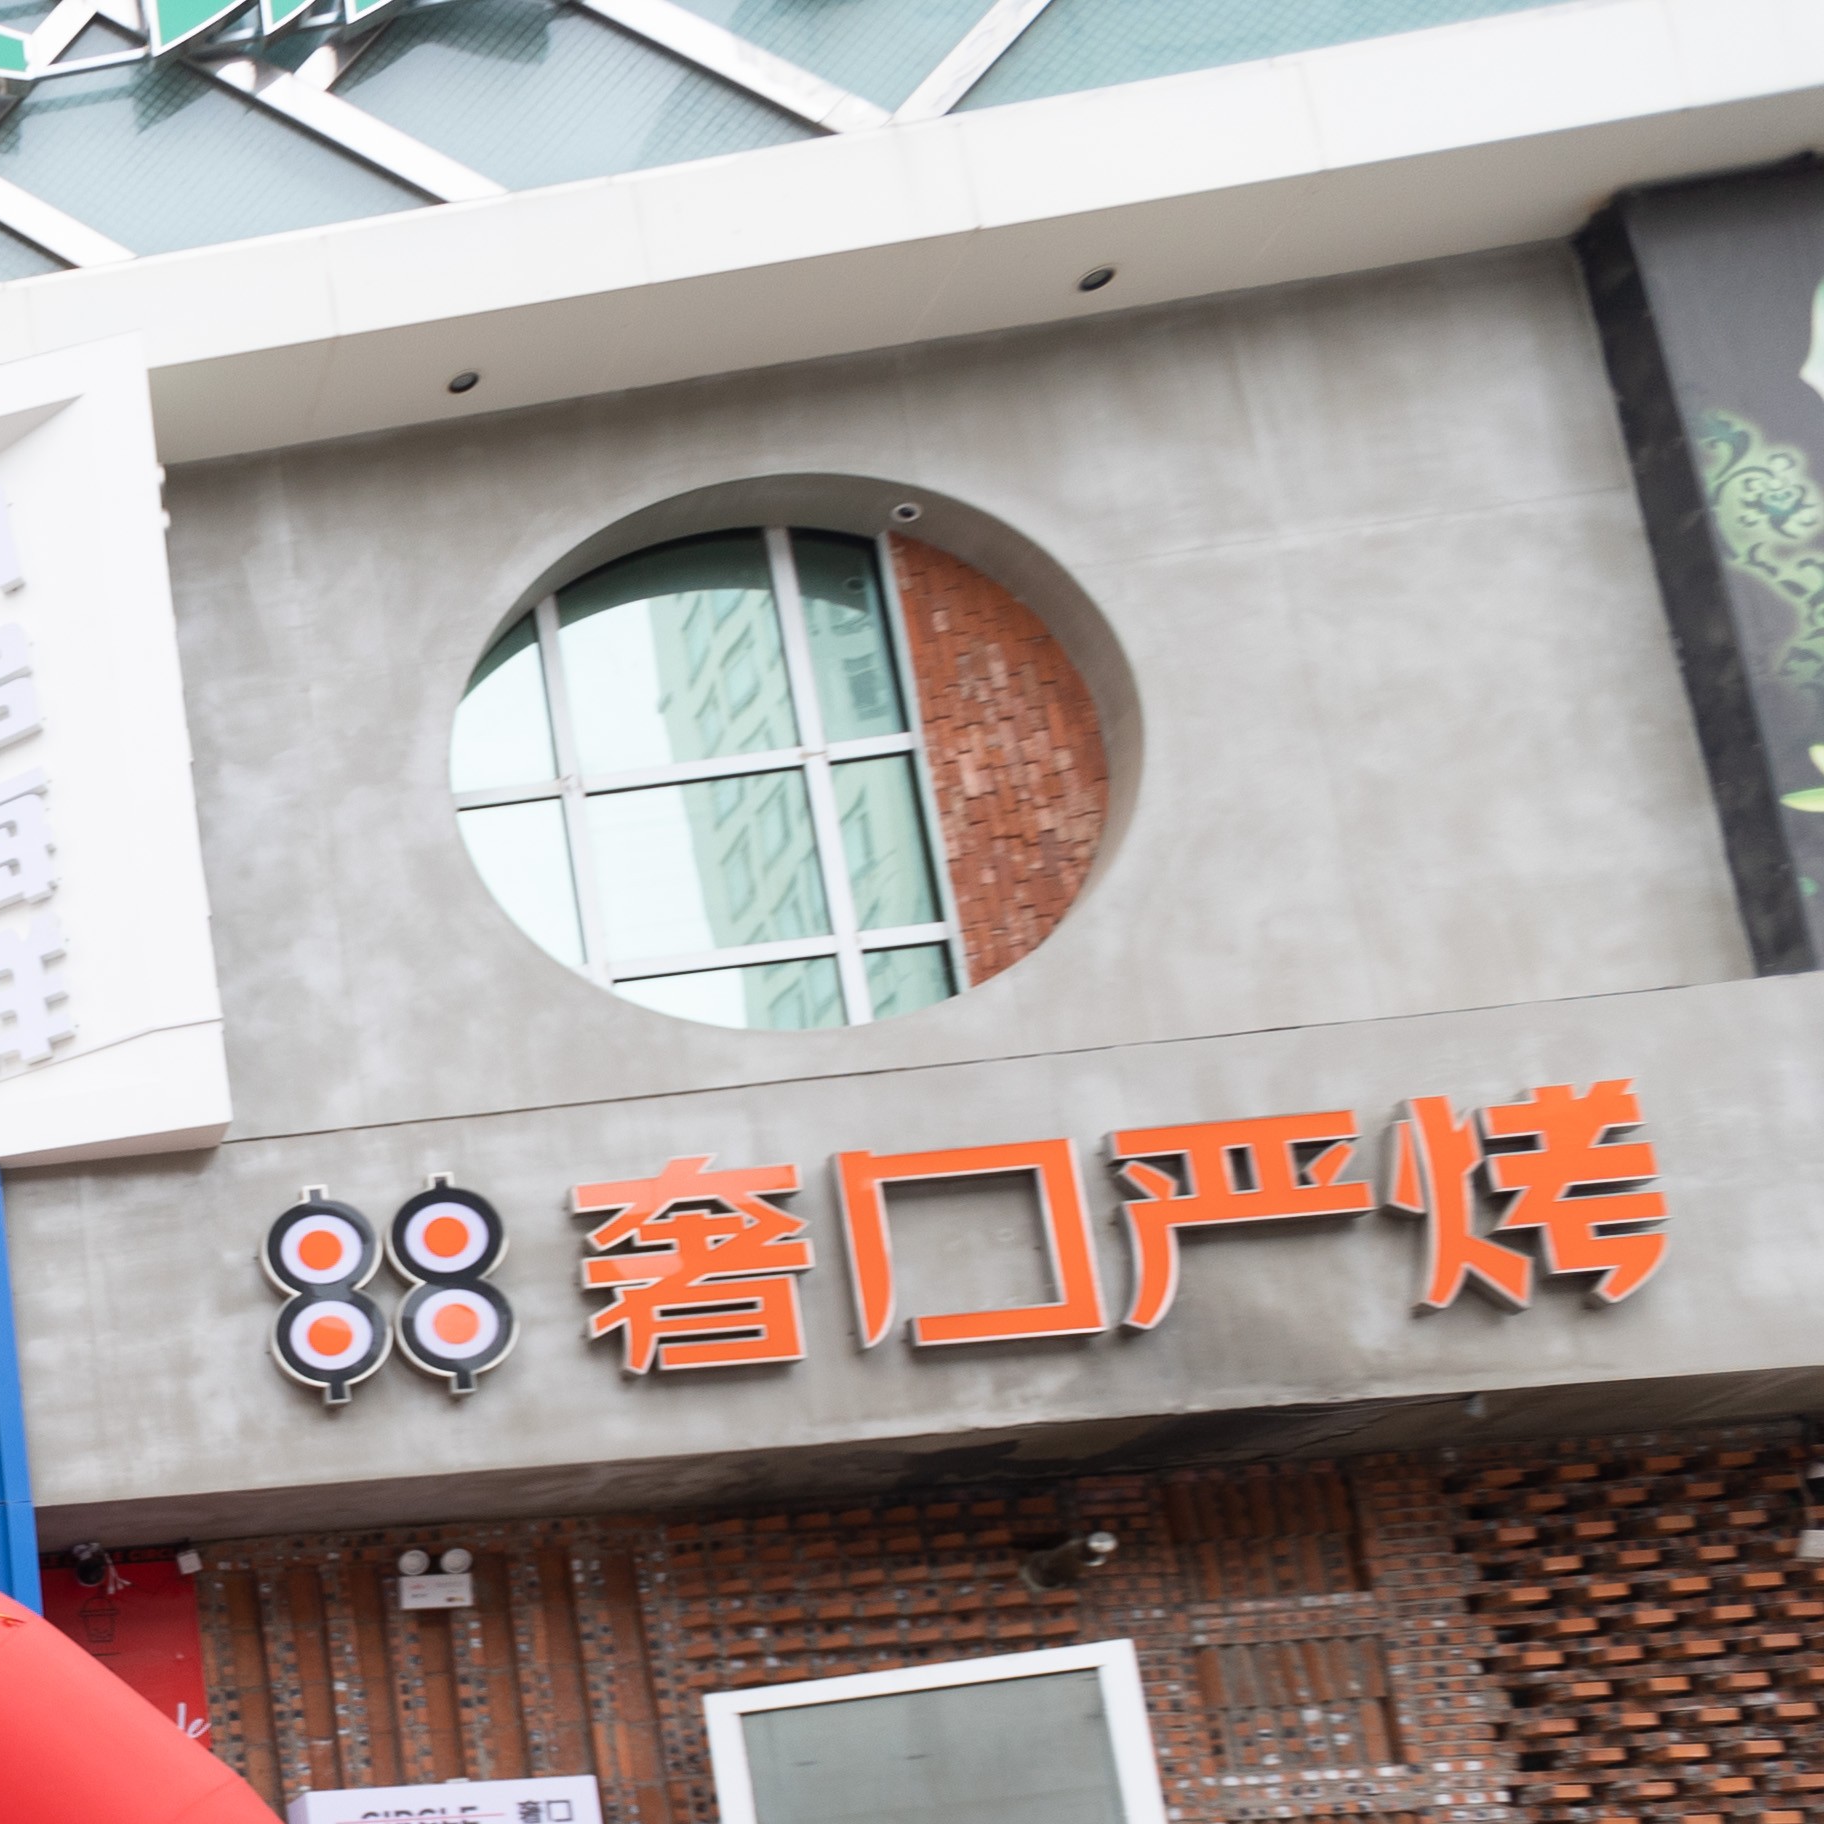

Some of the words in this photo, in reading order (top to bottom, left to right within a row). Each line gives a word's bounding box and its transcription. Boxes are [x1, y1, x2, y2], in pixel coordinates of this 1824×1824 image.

[567, 1078, 1674, 1379] 奢口严烤
[517, 1799, 574, 1824] 奢口
